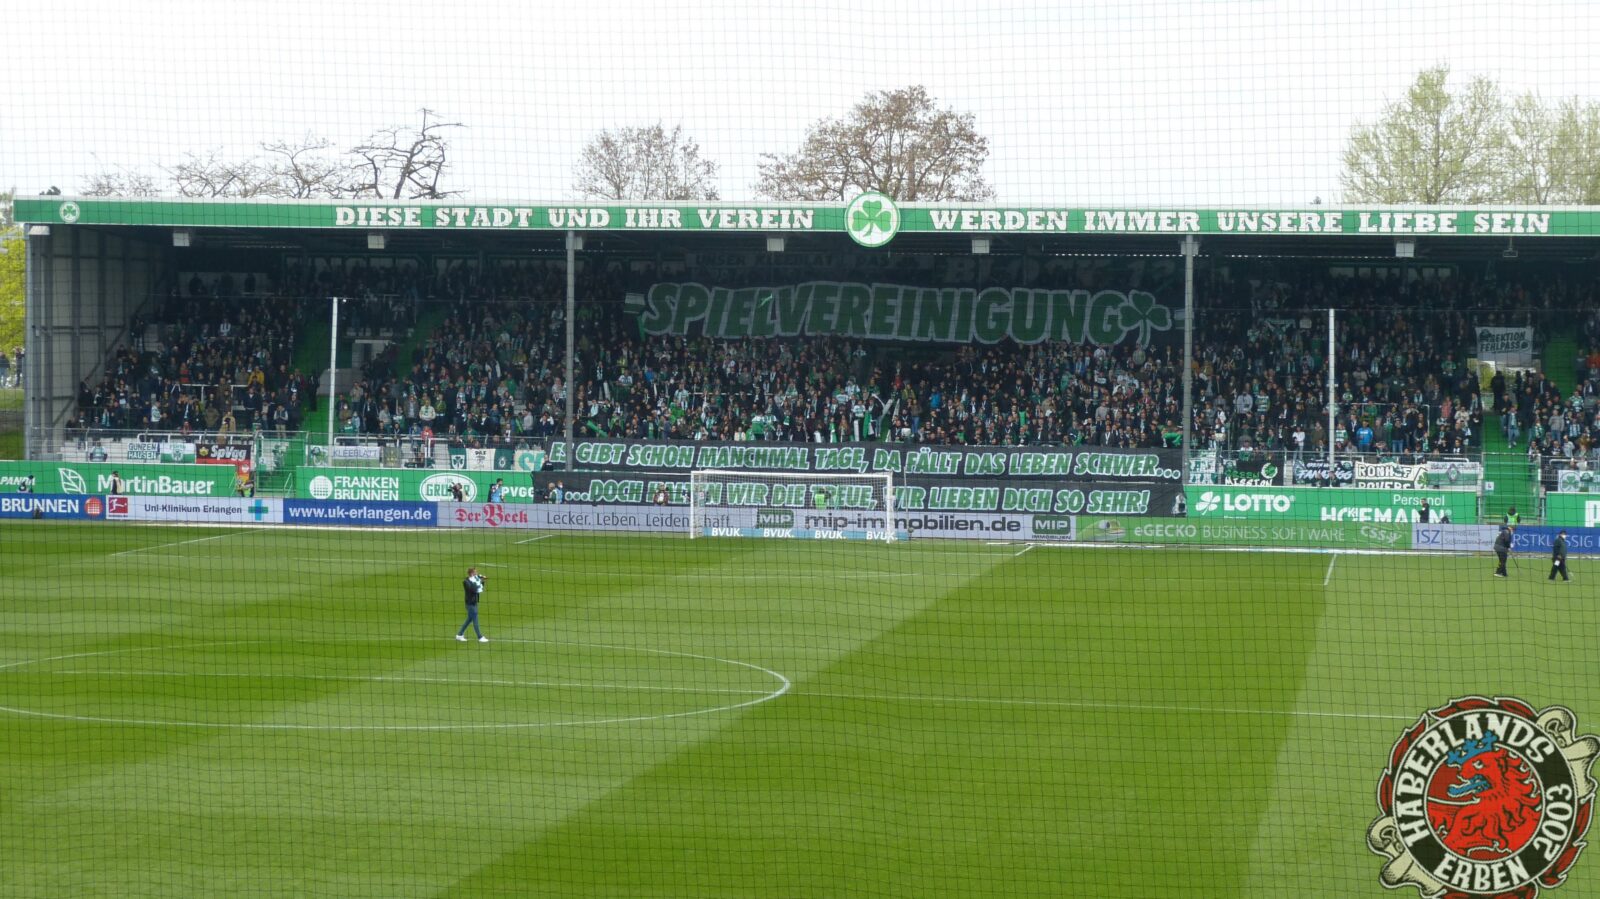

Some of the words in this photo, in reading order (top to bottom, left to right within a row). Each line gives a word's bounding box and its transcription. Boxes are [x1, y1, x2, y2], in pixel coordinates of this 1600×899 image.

[335, 207, 421, 227] DIESE
[435, 207, 533, 228] STADT
[548, 208, 611, 228] UND
[625, 208, 682, 228] IHR
[697, 208, 814, 229] VEREIN
[930, 210, 1069, 231] WERDEN
[1084, 211, 1200, 232] IMMER
[1217, 211, 1343, 233] UNSERE
[1358, 212, 1458, 233] LIEBE
[1474, 213, 1550, 234] SEIN
[642, 281, 1129, 345] SPIELVEREINIGUNG
[210, 444, 247, 462] SpVgg
[549, 442, 575, 463] ES
[576, 442, 626, 464] GIBT
[626, 443, 695, 468] SCHON
[696, 446, 810, 470] MANCHMAL
[815, 447, 869, 473] TAGE,
[873, 449, 902, 473] DA
[905, 447, 962, 475] FÄLLT
[964, 452, 1006, 475] DAS
[1008, 452, 1072, 476] LEBEN
[1074, 453, 1181, 479] SCHWER...
[98, 474, 215, 495] MrtinBauer
[333, 476, 400, 490] FRANKEN
[333, 488, 400, 501] BRUNNEN
[727, 482, 769, 506] WIR
[772, 483, 807, 508] DIE
[928, 487, 1000, 510] LIEBEN
[1002, 487, 1054, 512] DICH
[1054, 490, 1085, 514] SO
[1086, 490, 1151, 514] SEHR!
[1224, 493, 1291, 513] LOTTO
[2, 498, 79, 513] BRUNNEN
[144, 503, 201, 513] Uni-Klinikum
[203, 504, 242, 516] Erlangen
[289, 505, 432, 522] www.uk-erlangen.de
[455, 508, 481, 524] Der
[483, 503, 528, 526] Beck
[546, 511, 591, 526] Lecker.
[597, 512, 640, 527] Leben.
[760, 514, 792, 523] MIP
[1035, 519, 1068, 530] MIP
[1134, 524, 1196, 538] eGECKO
[1203, 525, 1267, 540] BUSINESS
[1272, 526, 1345, 542] SOFTWARE
[1416, 529, 1441, 544] ISZ
